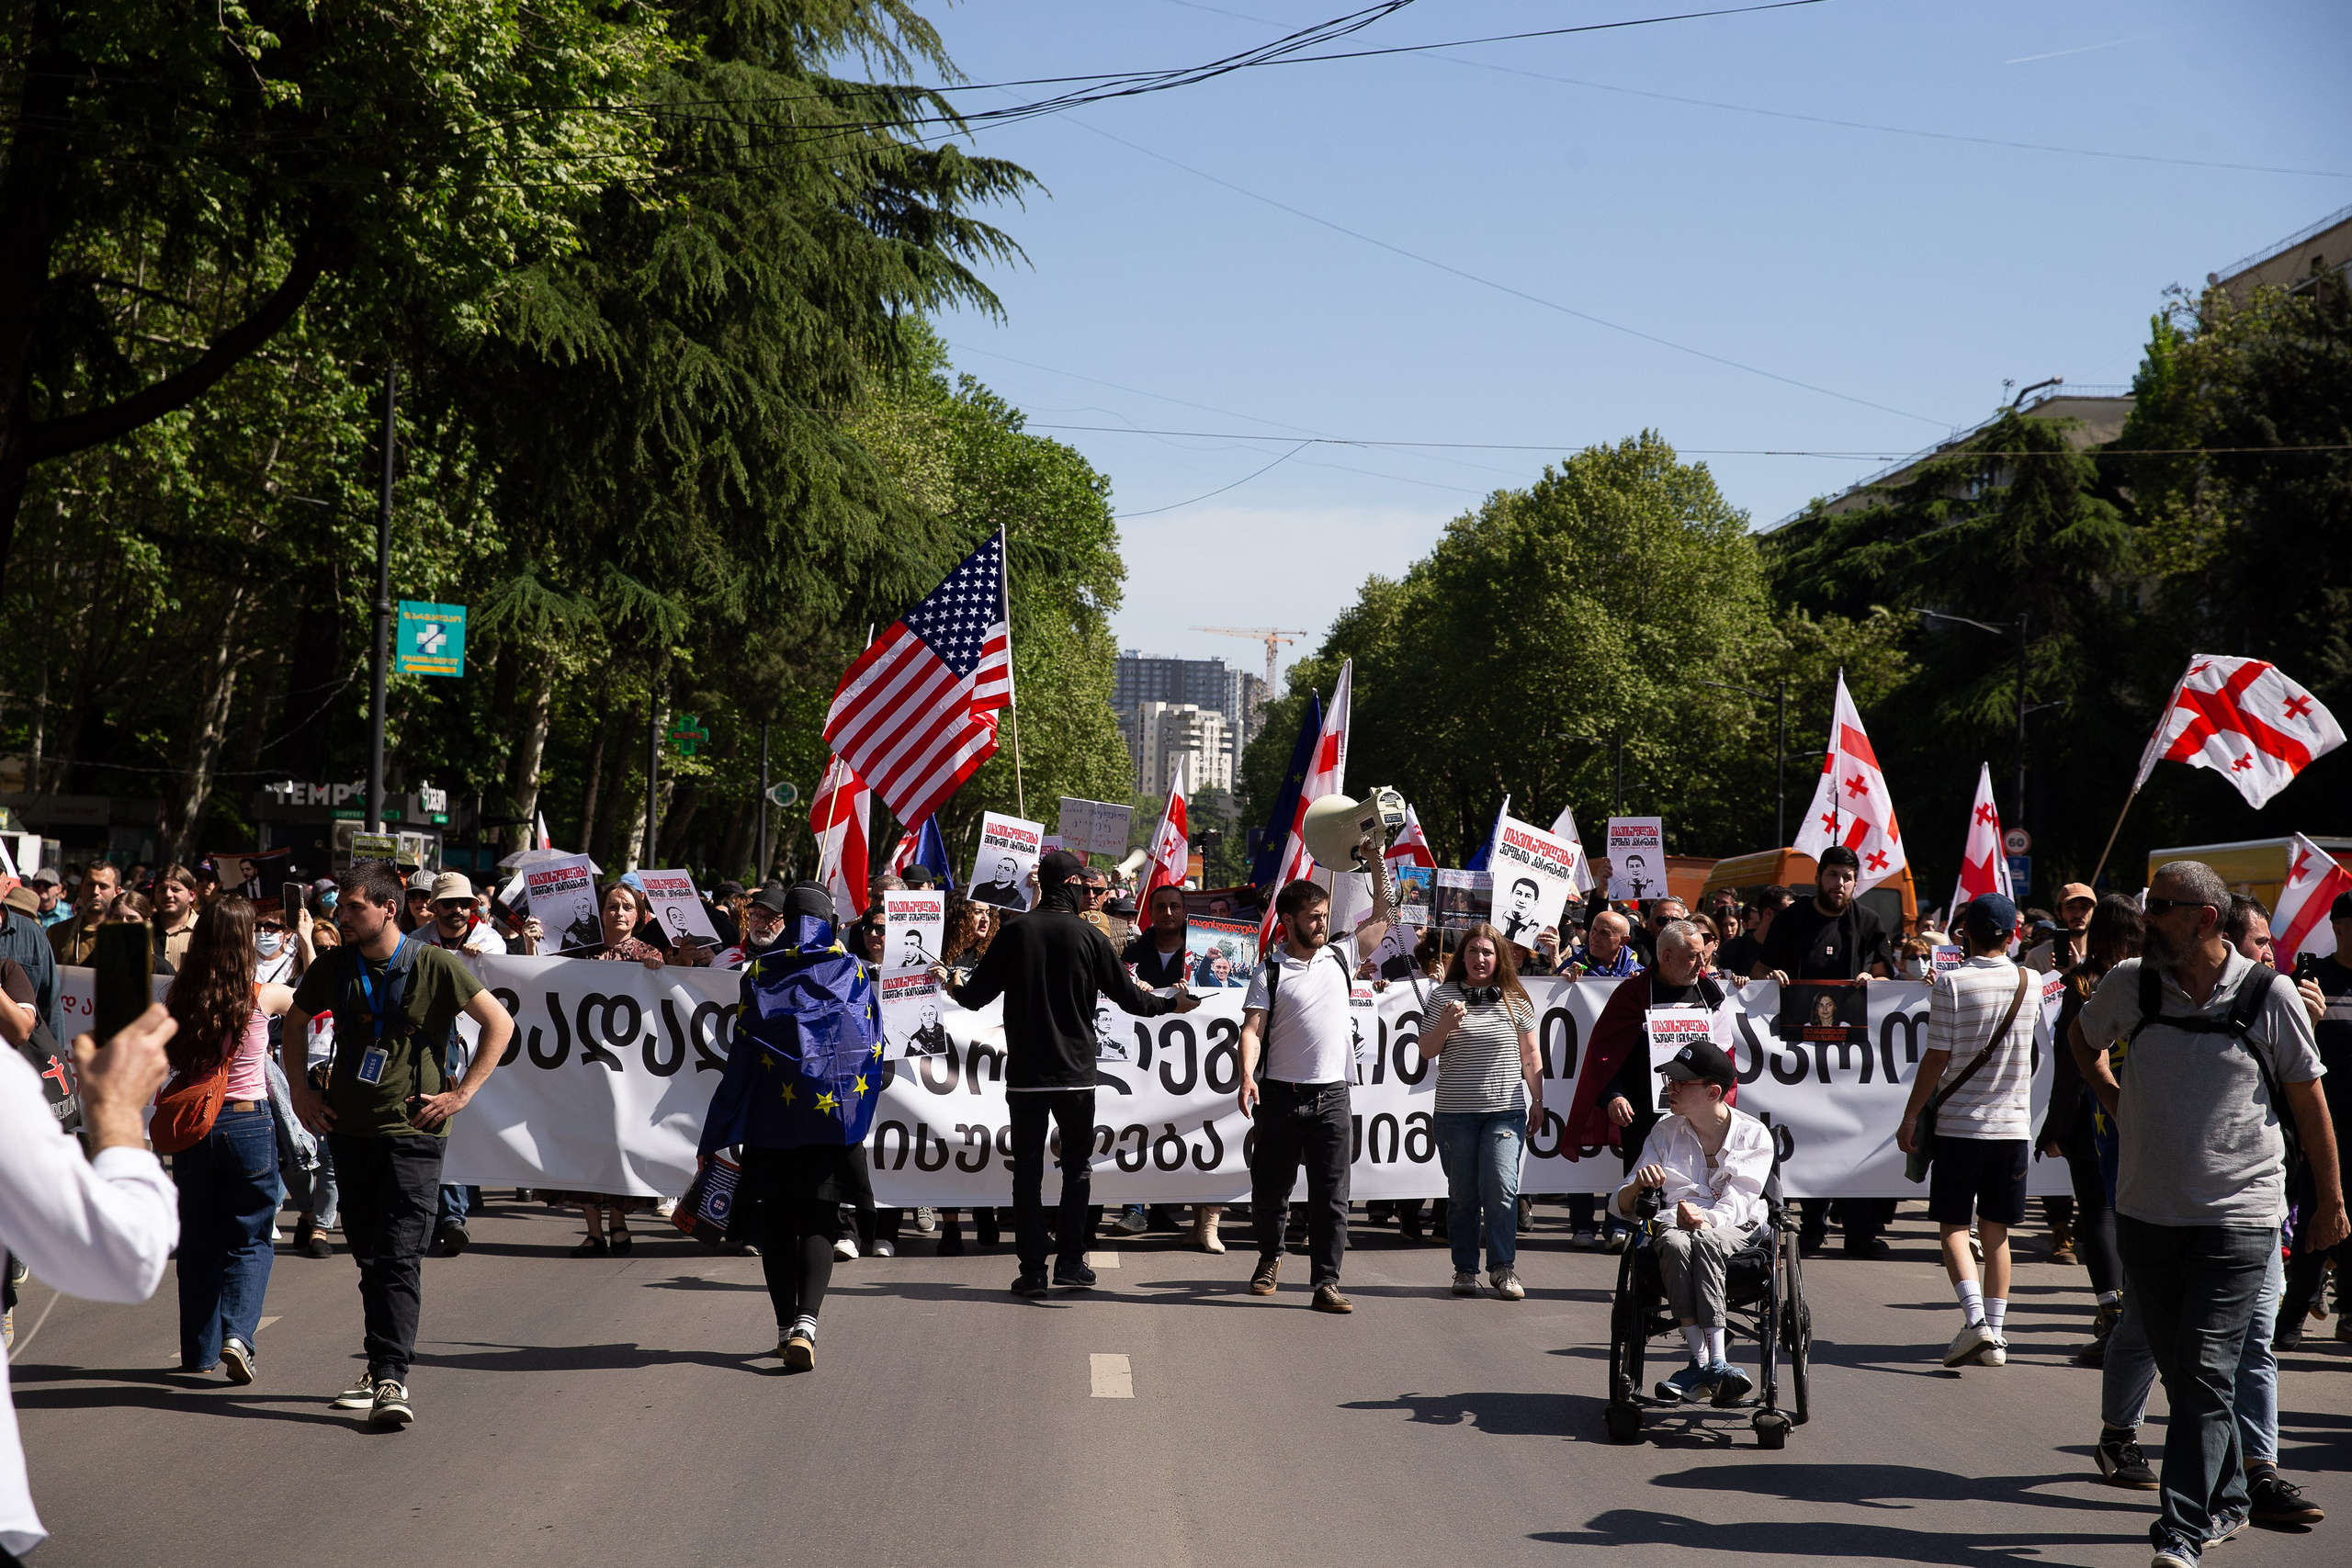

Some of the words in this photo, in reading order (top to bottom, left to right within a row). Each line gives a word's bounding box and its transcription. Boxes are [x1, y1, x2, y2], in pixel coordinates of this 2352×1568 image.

[401, 655, 458, 665] PHARMADEPOT
[986, 821, 1039, 845] თავისუფლება
[1611, 826, 1658, 837] თავისუფლება
[1503, 827, 1575, 868] თავისუფლება
[2008, 838, 2025, 847] 60
[1498, 842, 1531, 864] ვეფხია
[1531, 856, 1570, 880] კასრაძეს
[528, 865, 588, 886] თავისუფლება
[888, 900, 941, 912] თავისუფლება
[1189, 919, 1259, 935] თავისუფლება
[1651, 1020, 1710, 1032] თავისუფლება
[367, 1057, 377, 1078] PRESS
[51, 1093, 77, 1121] BERLIN
